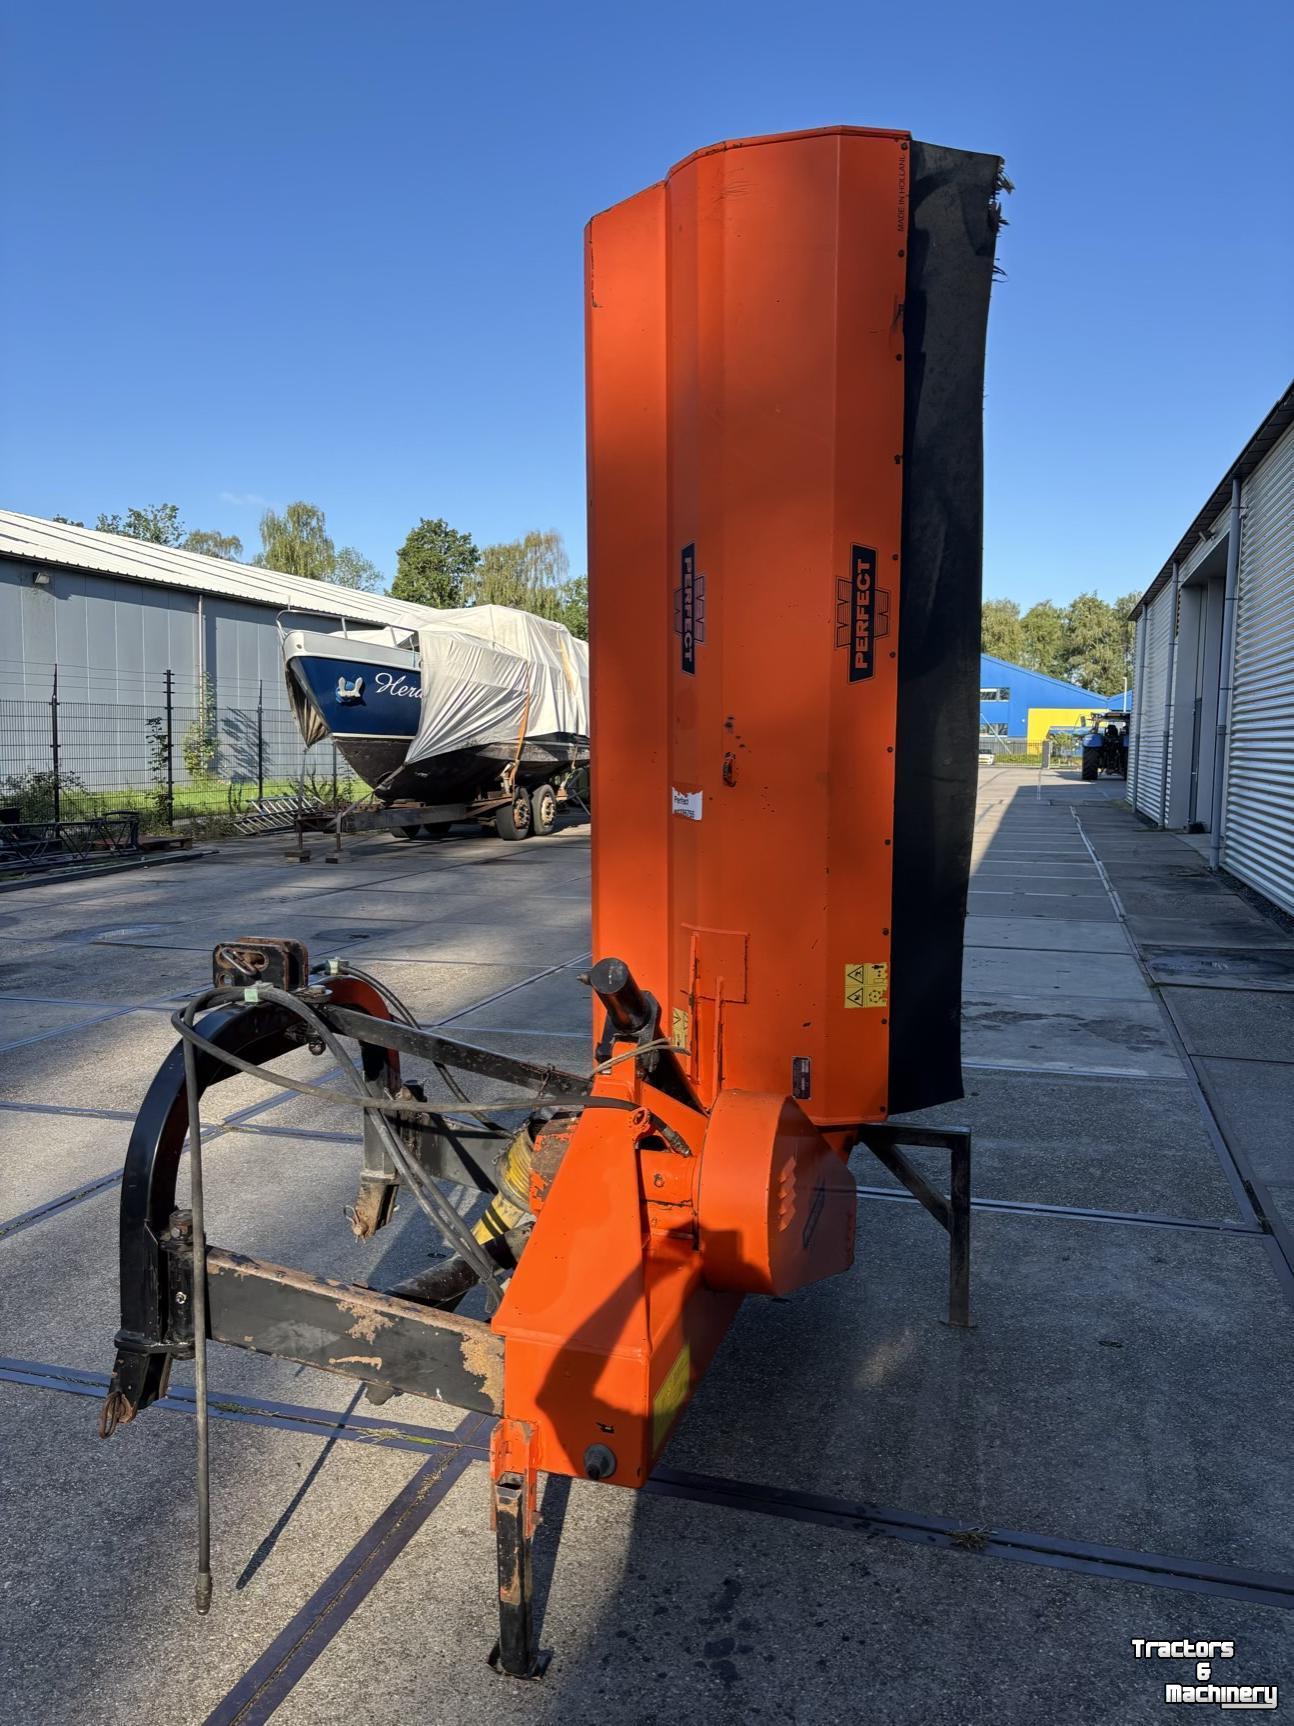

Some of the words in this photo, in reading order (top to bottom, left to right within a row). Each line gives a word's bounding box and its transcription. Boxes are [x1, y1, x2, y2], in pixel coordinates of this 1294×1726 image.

[897, 207, 905, 232] MADE
[898, 195, 905, 205] IN
[684, 557, 693, 662] PERFECT
[855, 558, 871, 669] PERFECT
